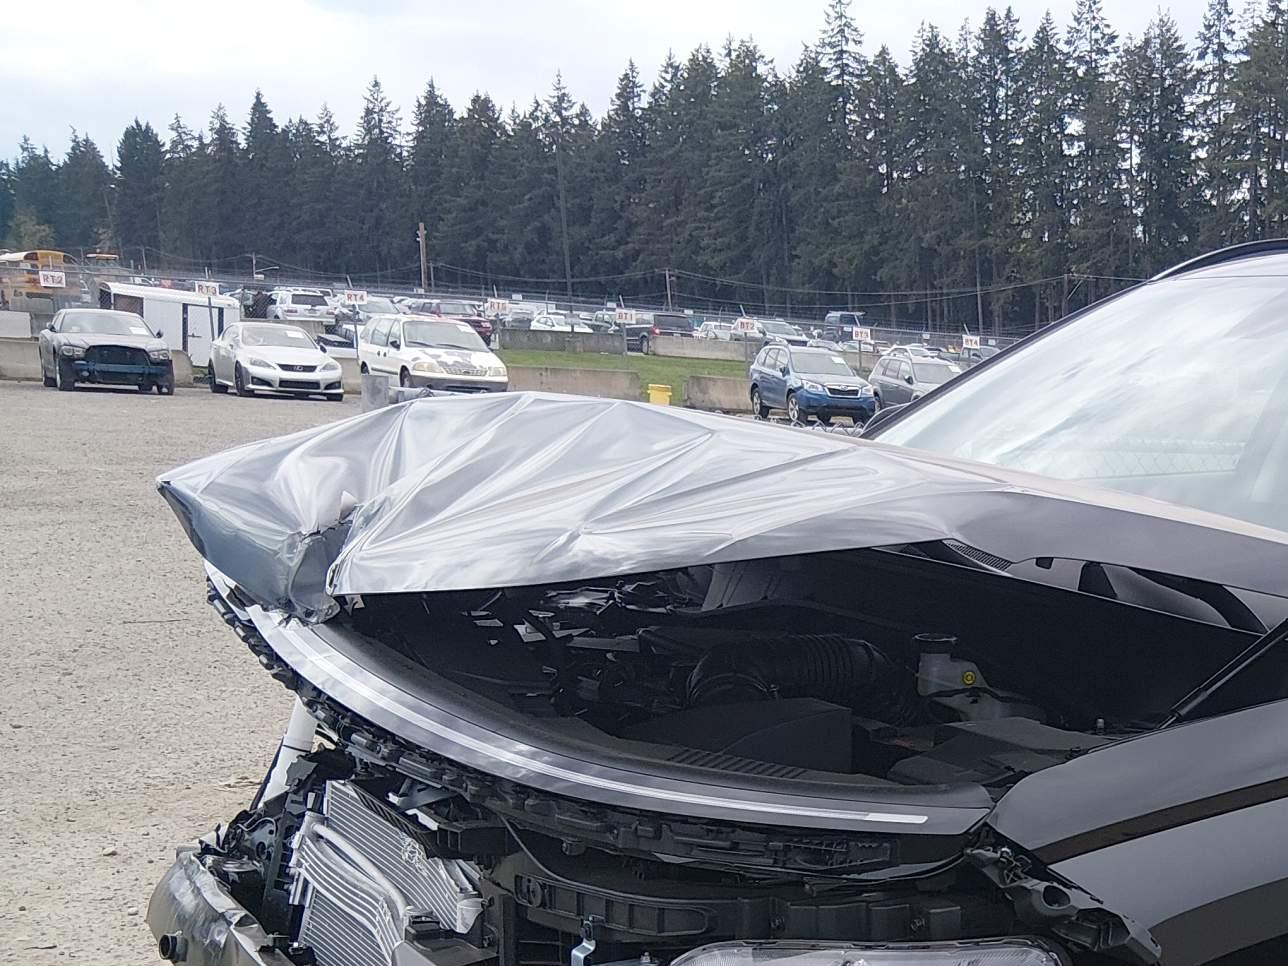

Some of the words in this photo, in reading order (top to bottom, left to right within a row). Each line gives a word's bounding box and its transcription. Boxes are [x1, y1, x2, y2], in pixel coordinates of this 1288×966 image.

[42, 273, 64, 284] RT2
[197, 284, 217, 296] RT3
[346, 293, 365, 302] RT4
